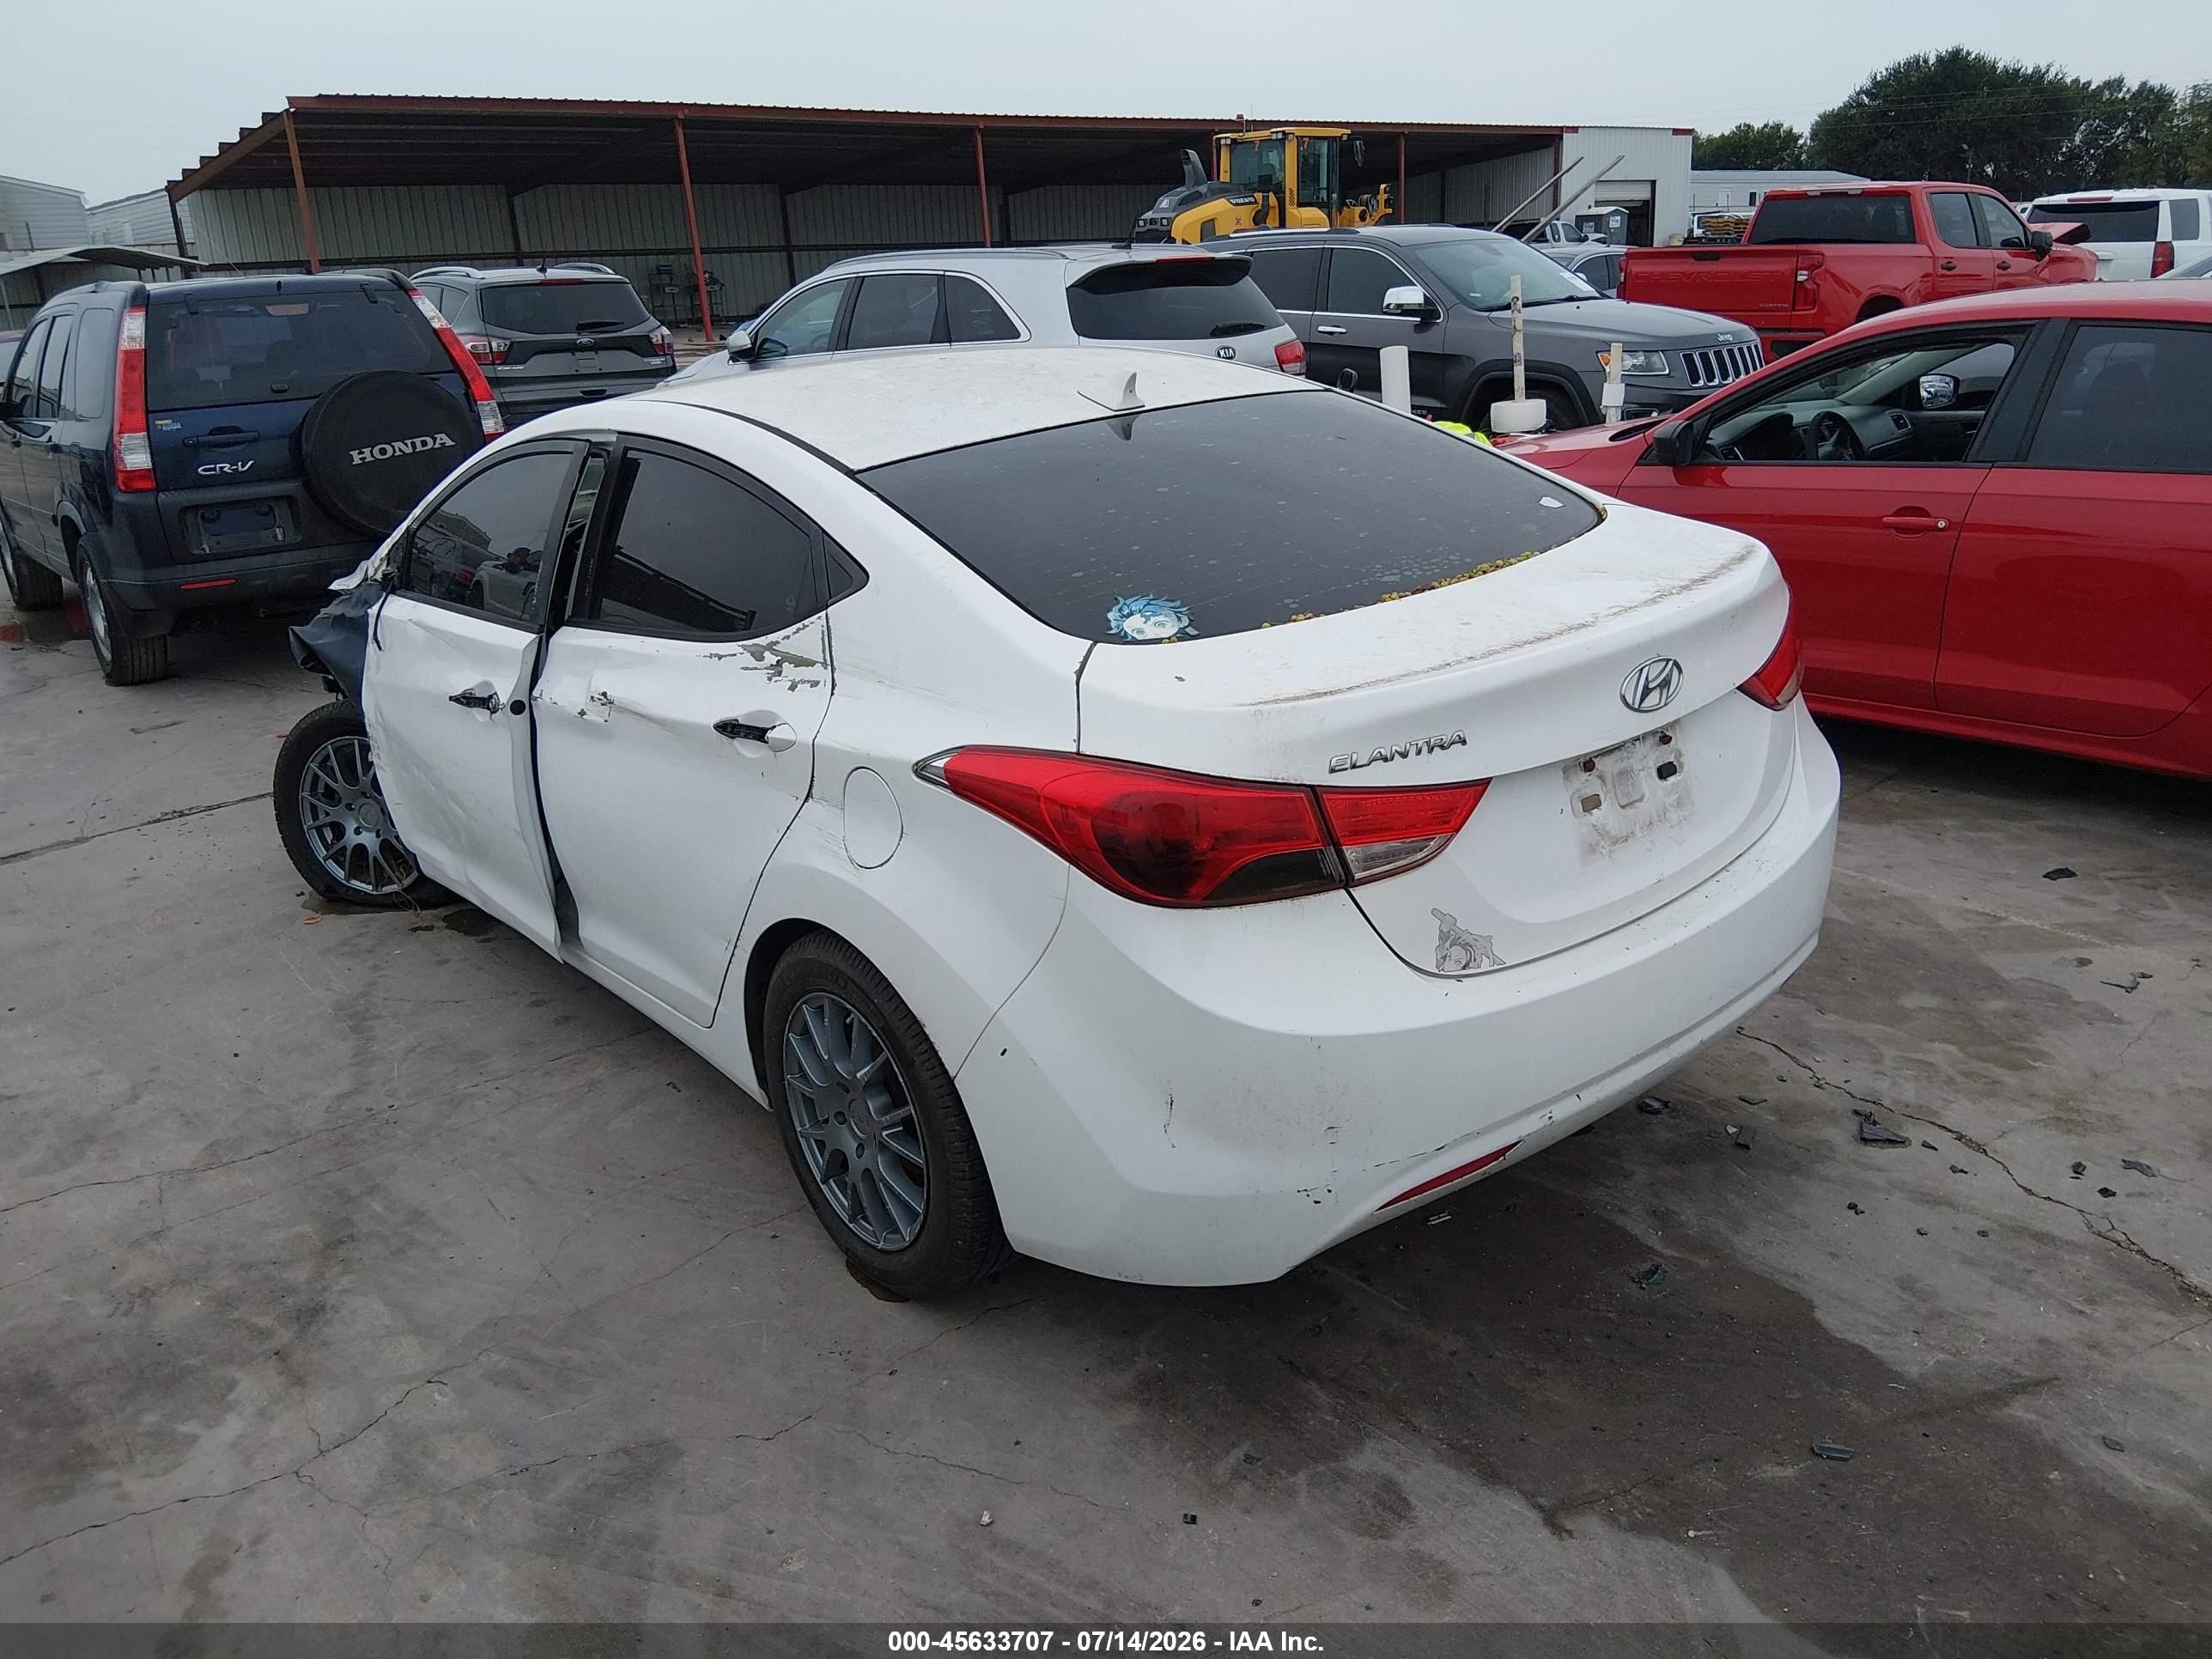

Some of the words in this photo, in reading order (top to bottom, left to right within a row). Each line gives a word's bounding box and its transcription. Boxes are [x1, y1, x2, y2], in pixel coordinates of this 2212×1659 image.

[1717, 333, 1733, 342] Jeep
[1219, 348, 1234, 358] KIA
[349, 434, 456, 465] HONDA
[198, 460, 254, 475] CR-V
[1328, 729, 1468, 774] ELANTRA
